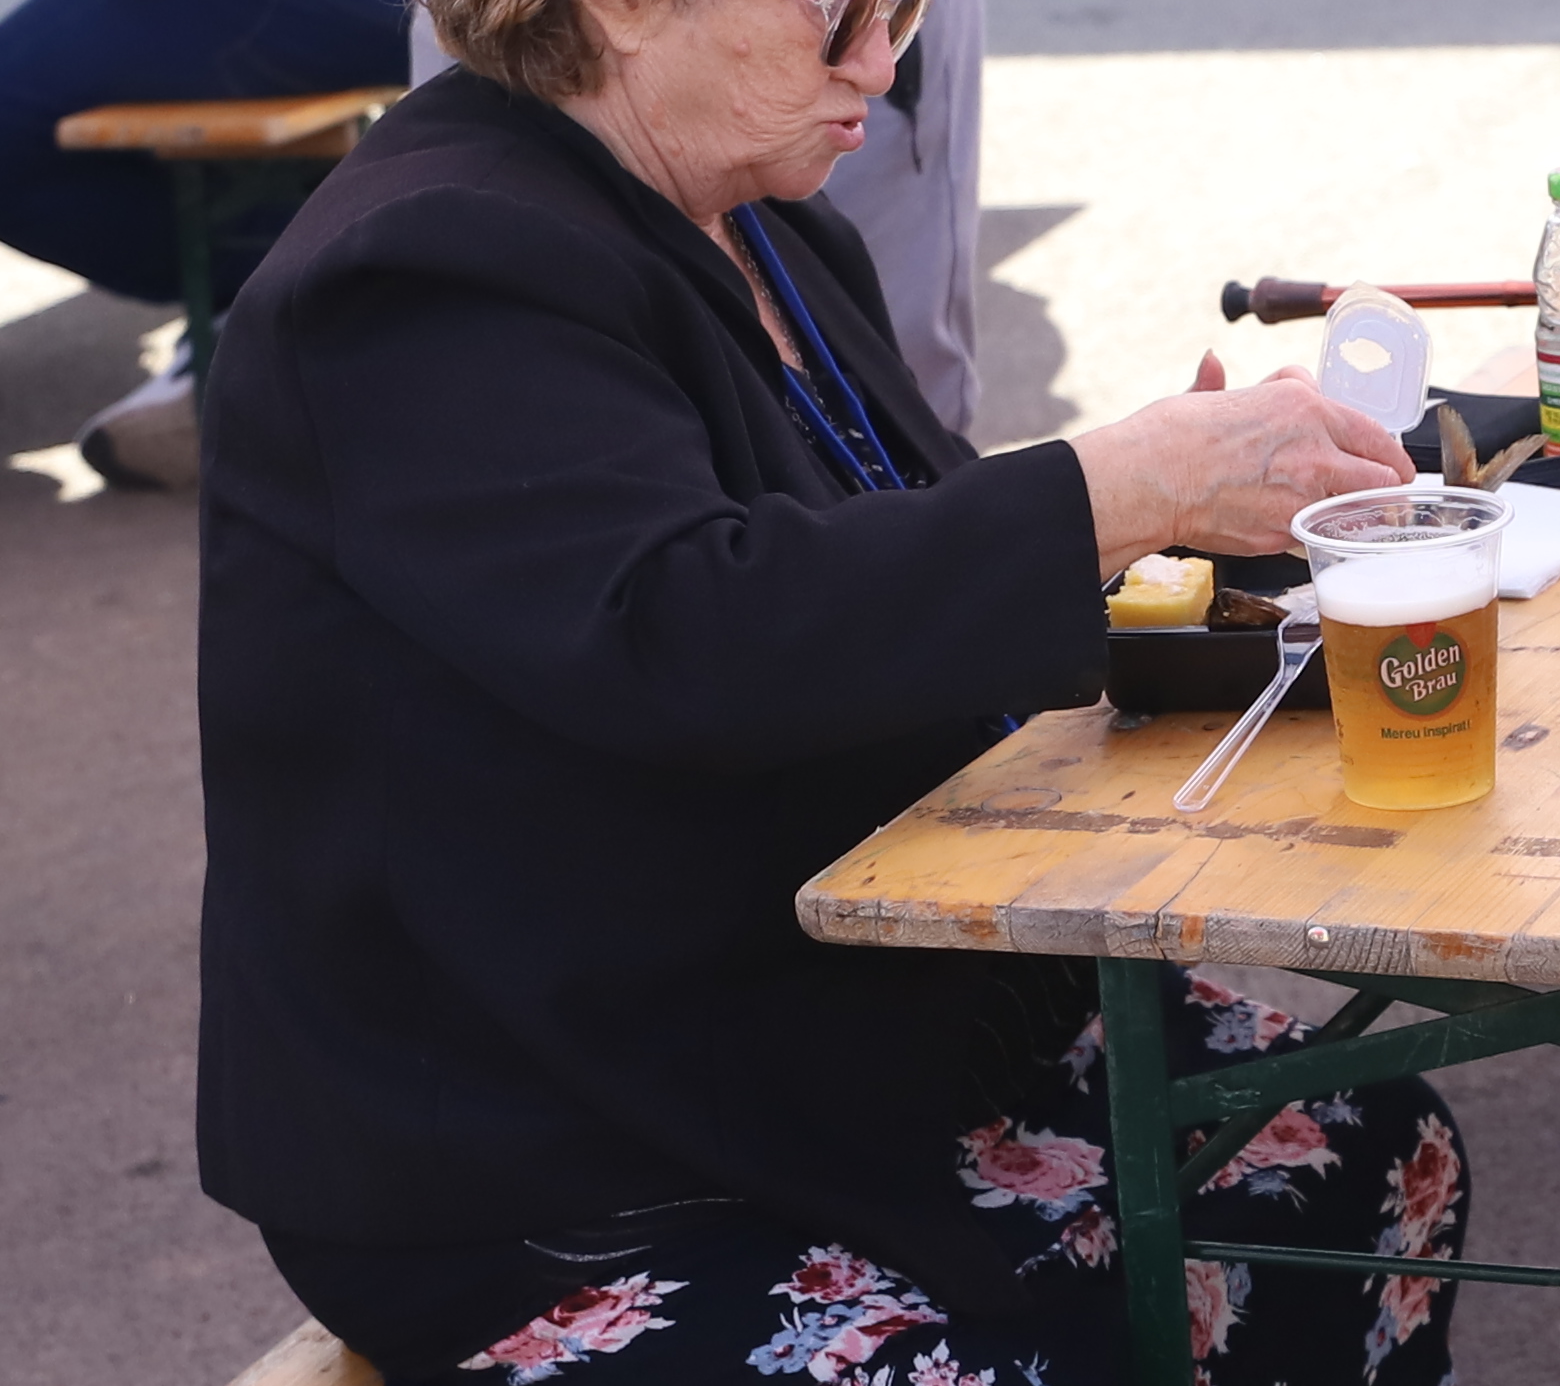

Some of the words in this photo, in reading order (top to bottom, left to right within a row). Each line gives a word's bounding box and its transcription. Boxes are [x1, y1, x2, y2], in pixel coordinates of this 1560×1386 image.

[1380, 644, 1460, 688] Golden
[1405, 672, 1457, 702] Brau
[1381, 728, 1420, 739] Mereu
